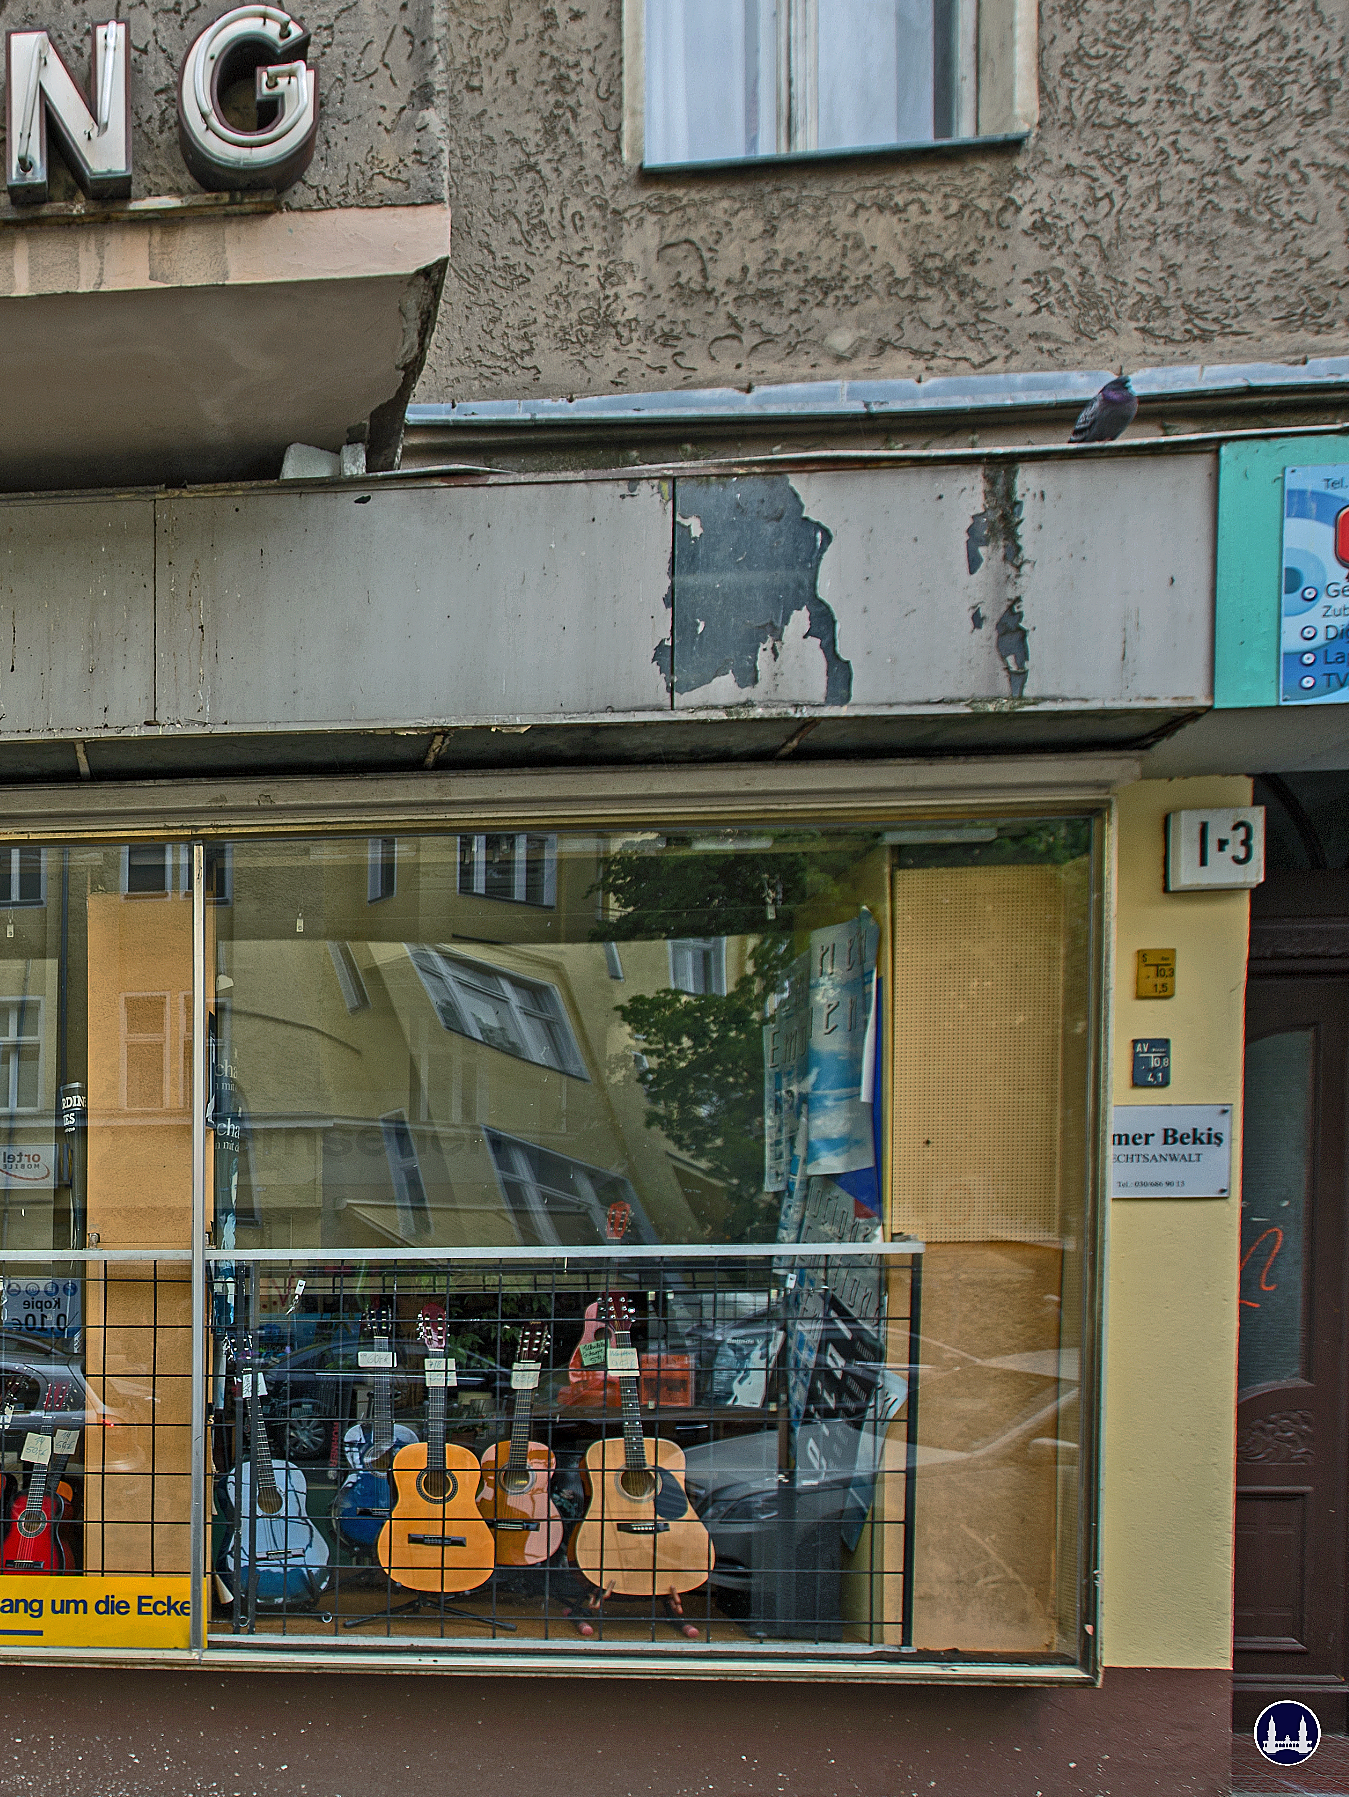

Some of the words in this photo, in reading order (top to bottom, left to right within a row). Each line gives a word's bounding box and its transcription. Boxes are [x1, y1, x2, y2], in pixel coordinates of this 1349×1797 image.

[1324, 651, 1349, 666] La
[1136, 1043, 1149, 1053] AV
[1147, 1072, 1163, 1085] 4,1
[1162, 1127, 1224, 1147] Bekiş
[51, 1598, 88, 1615] um
[94, 1595, 131, 1615] die
[137, 1596, 191, 1617] Ecke
